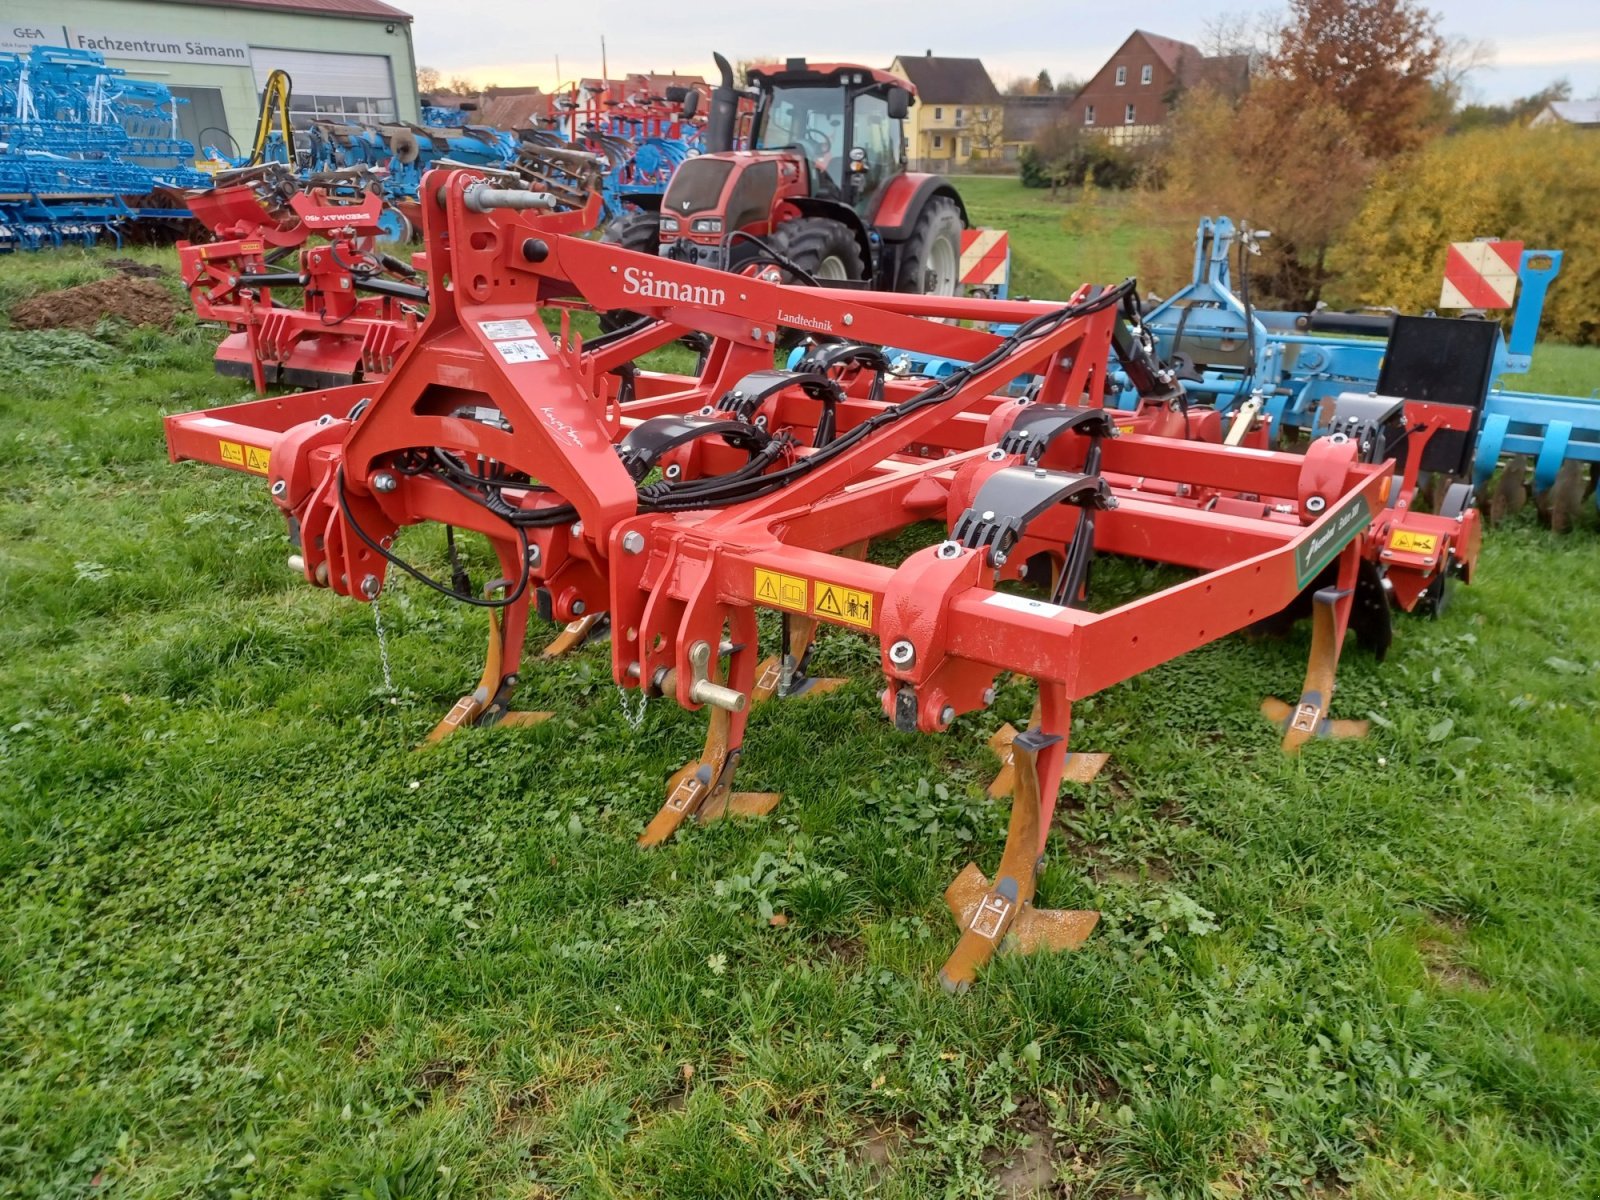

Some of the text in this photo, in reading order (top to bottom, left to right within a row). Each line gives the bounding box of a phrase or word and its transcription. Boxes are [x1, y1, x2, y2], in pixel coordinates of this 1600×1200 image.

[13, 27, 45, 39] GEA
[77, 35, 245, 58] Fachzentrum Sämann
[622, 266, 726, 307] Sämann
[777, 309, 833, 332] Landtechnik
